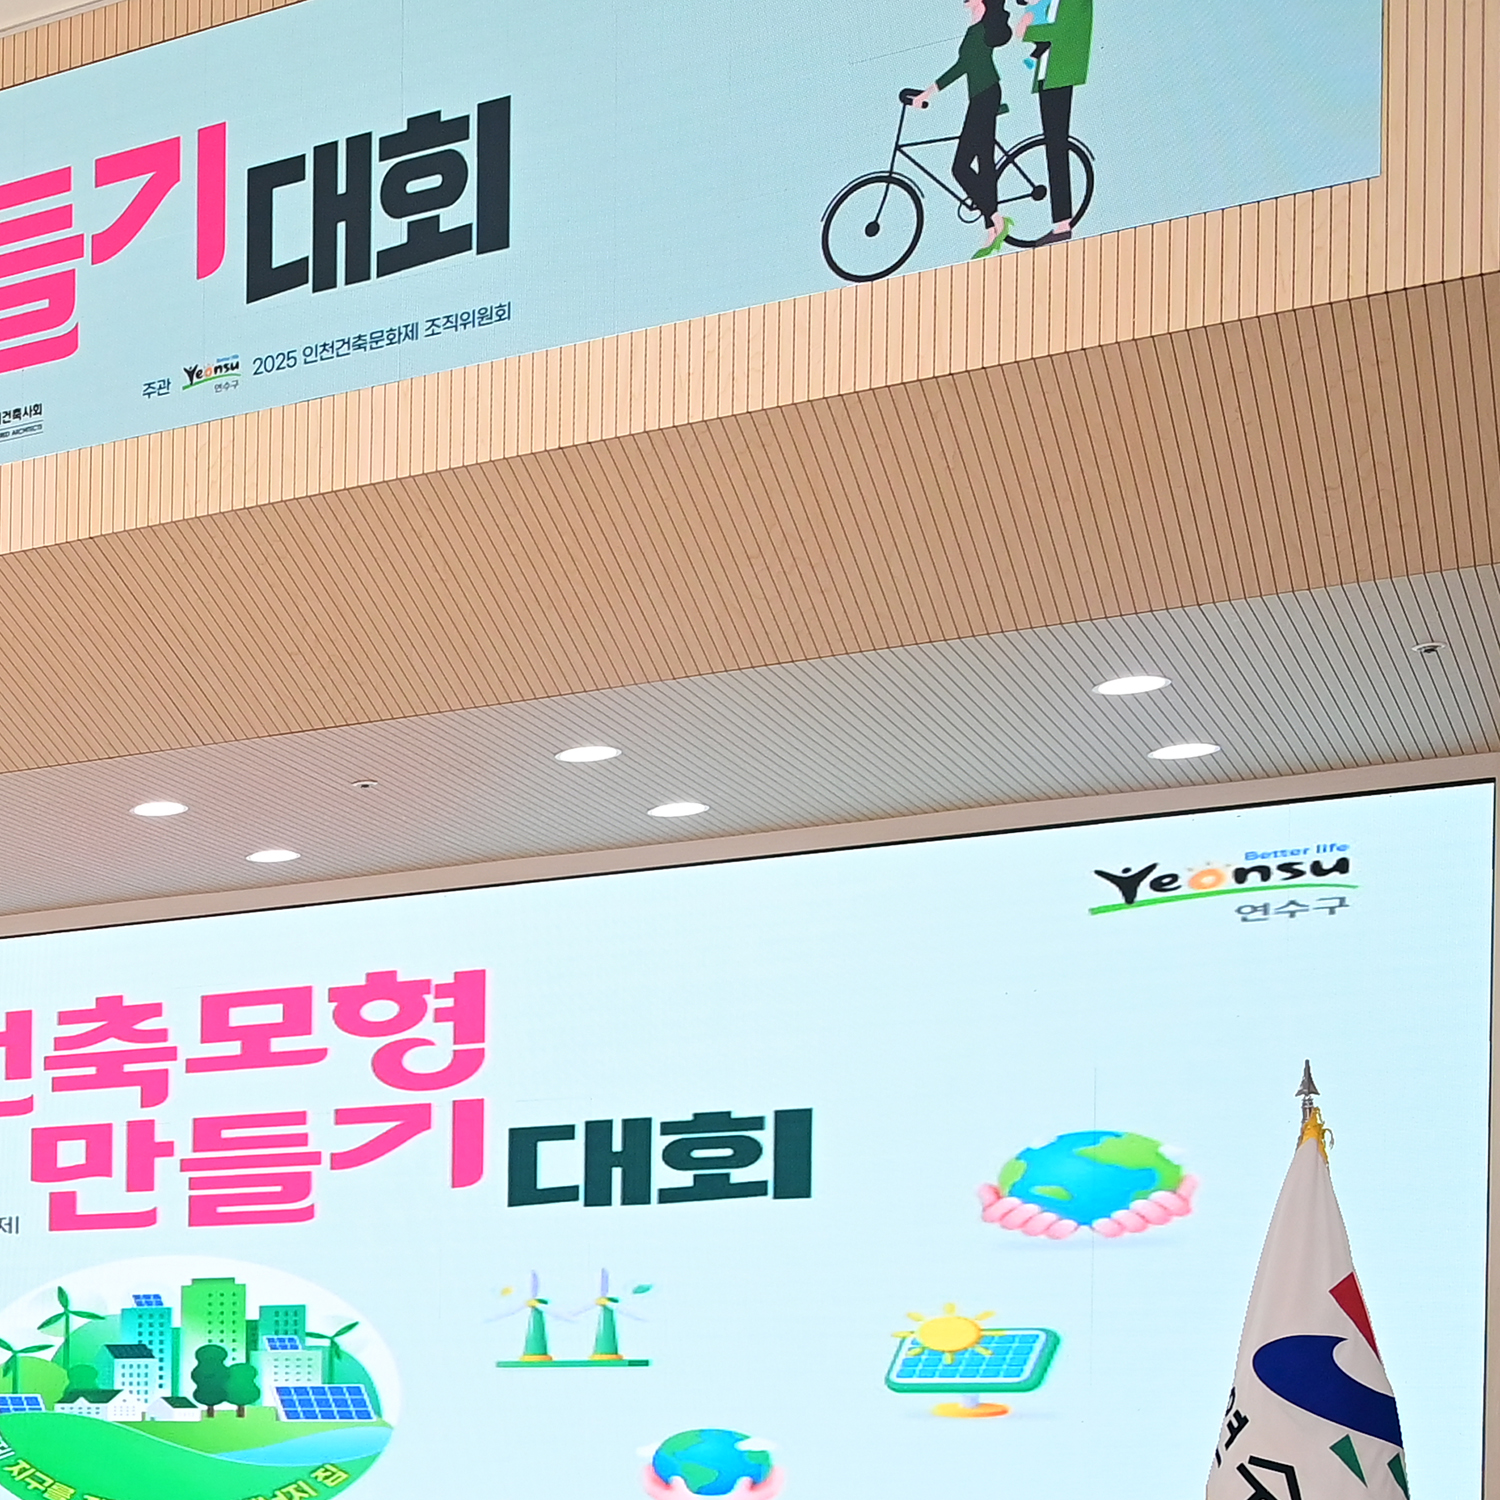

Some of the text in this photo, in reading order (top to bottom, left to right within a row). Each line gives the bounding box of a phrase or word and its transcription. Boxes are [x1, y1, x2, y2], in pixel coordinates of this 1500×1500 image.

[245, 95, 512, 305] 대회
[251, 301, 513, 376] 2025 인천건축문화제 조직위원회
[183, 360, 240, 386] Yeonsu
[141, 377, 172, 400] 주관
[1244, 842, 1350, 862] Better life
[1094, 856, 1350, 905] Yeonsu
[1234, 896, 1350, 923] 연수구
[30, 1097, 814, 1232] 만들기 대회
[310, 1463, 350, 1488] 집
